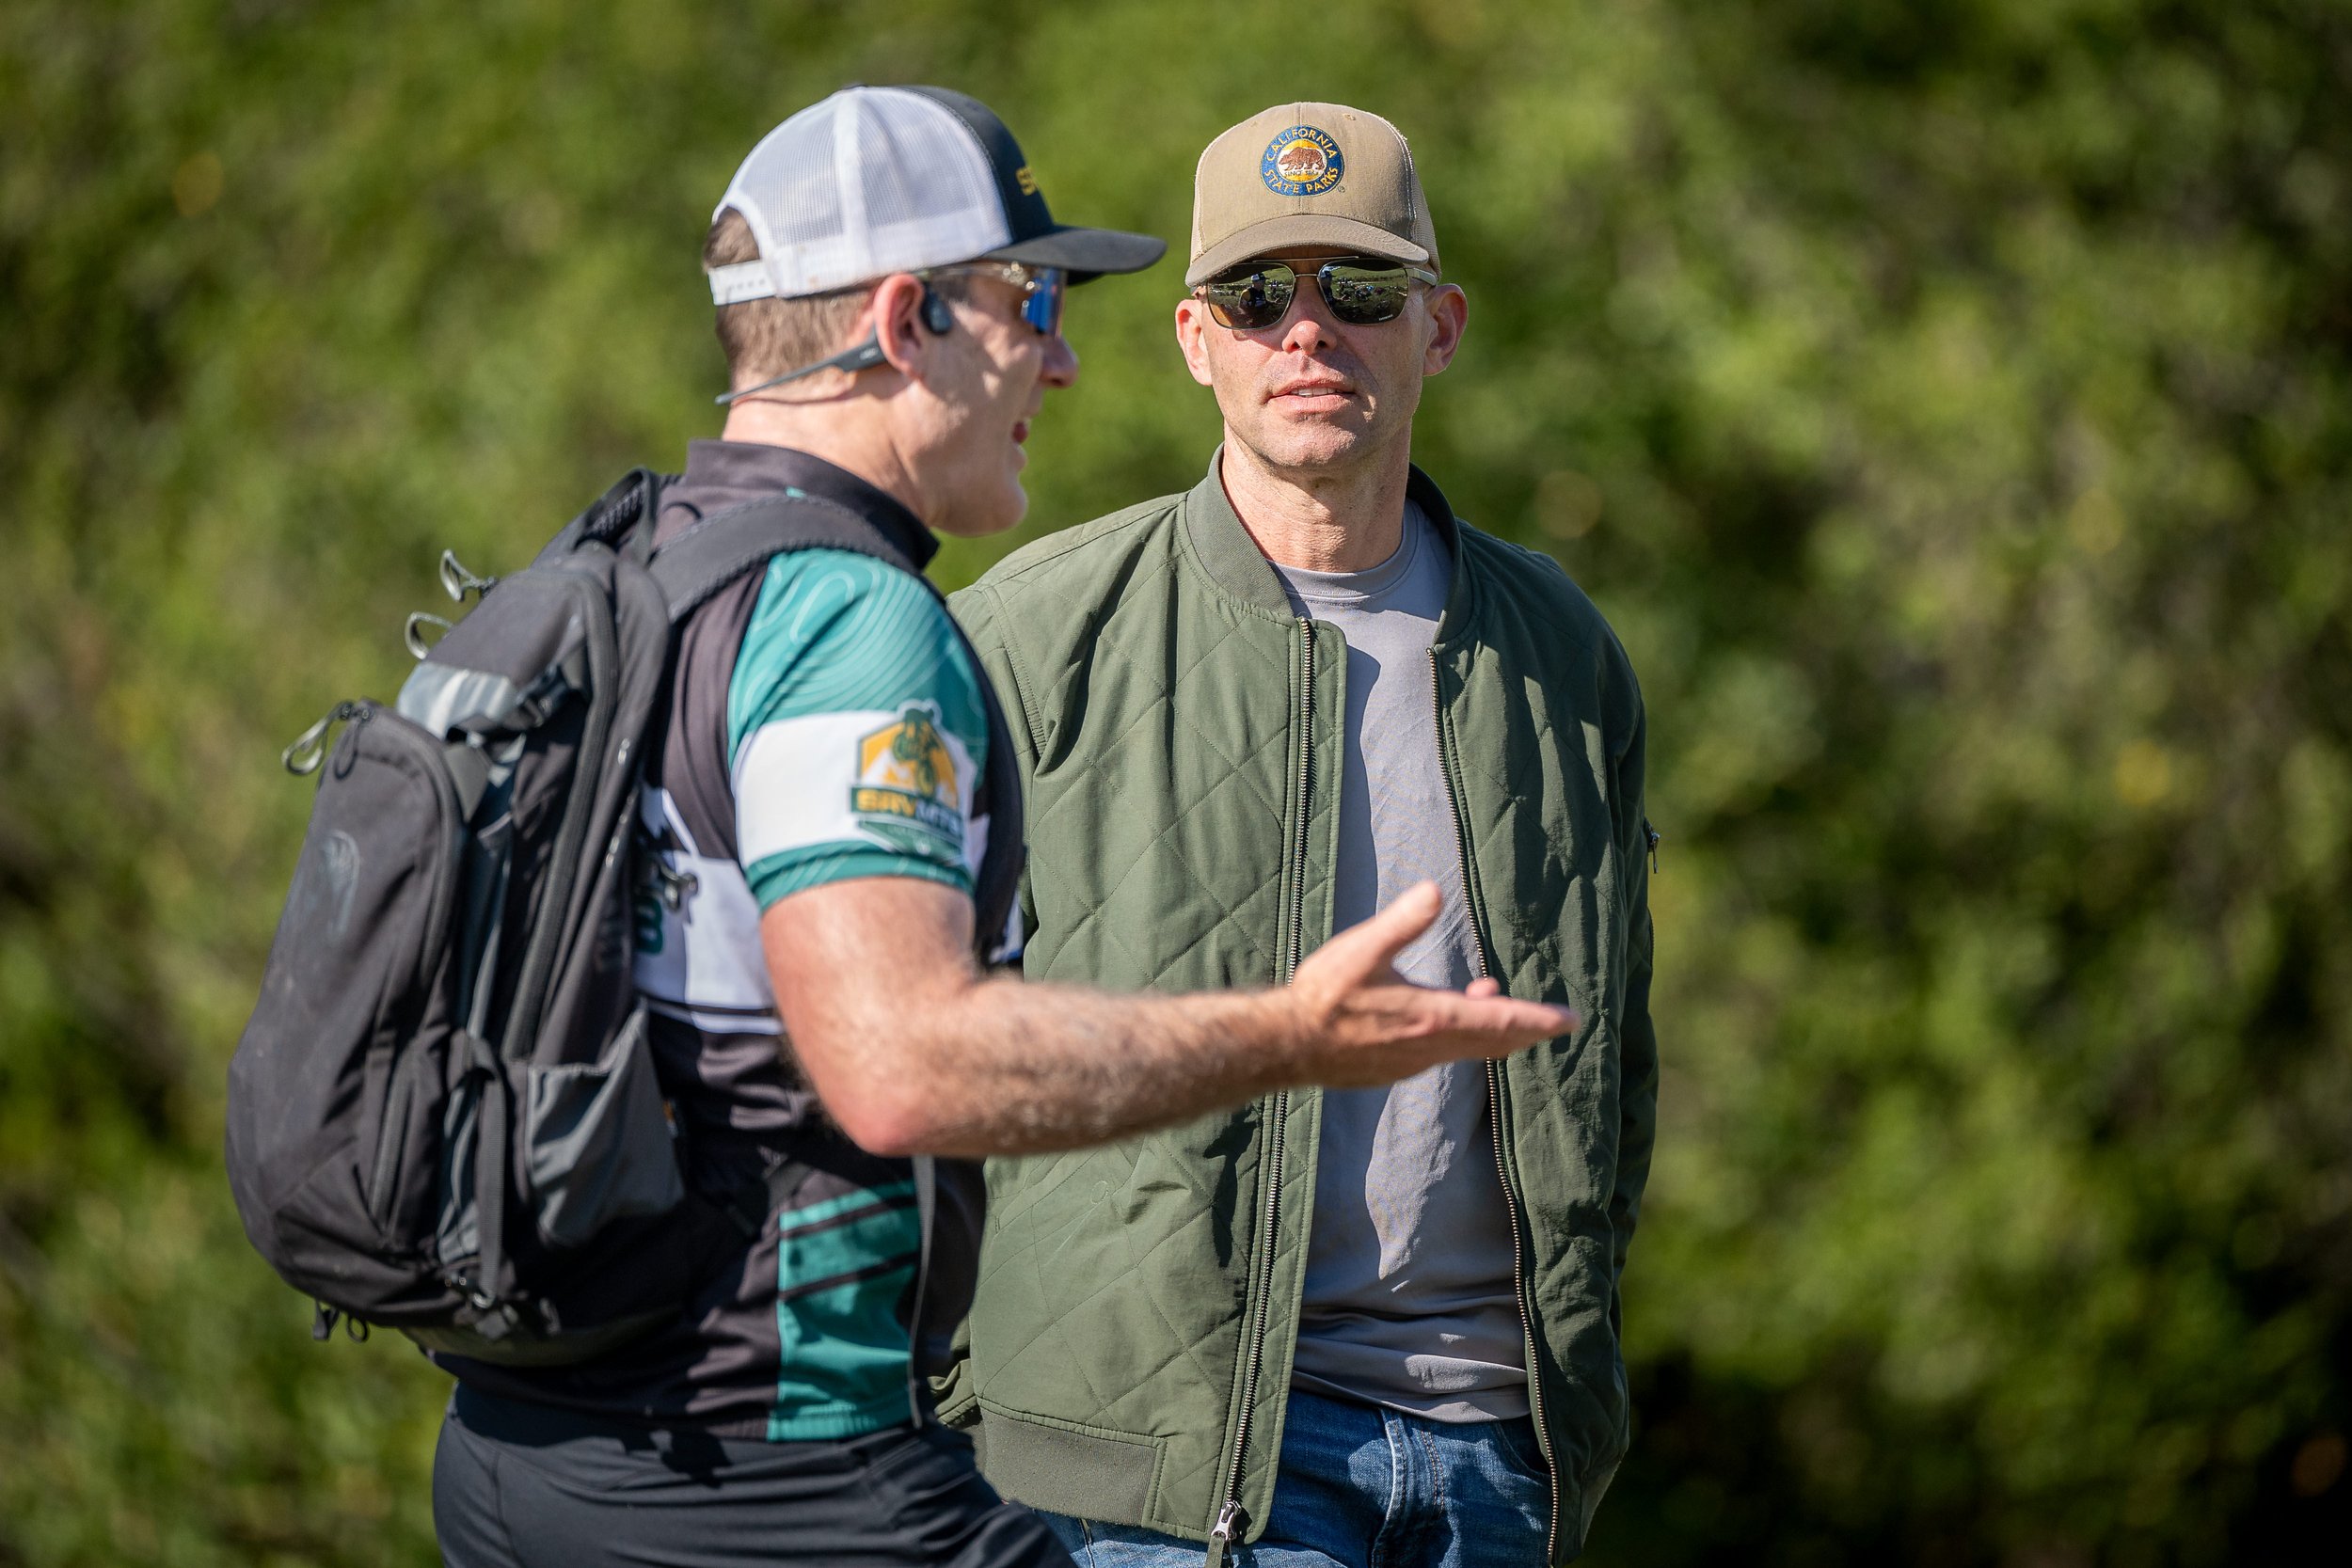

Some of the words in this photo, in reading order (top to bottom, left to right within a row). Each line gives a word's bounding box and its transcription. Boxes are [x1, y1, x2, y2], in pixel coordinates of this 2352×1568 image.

[1266, 128, 1338, 161] CALIFORNIA
[1264, 169, 1300, 194] STATE
[1306, 167, 1339, 193] PARKS
